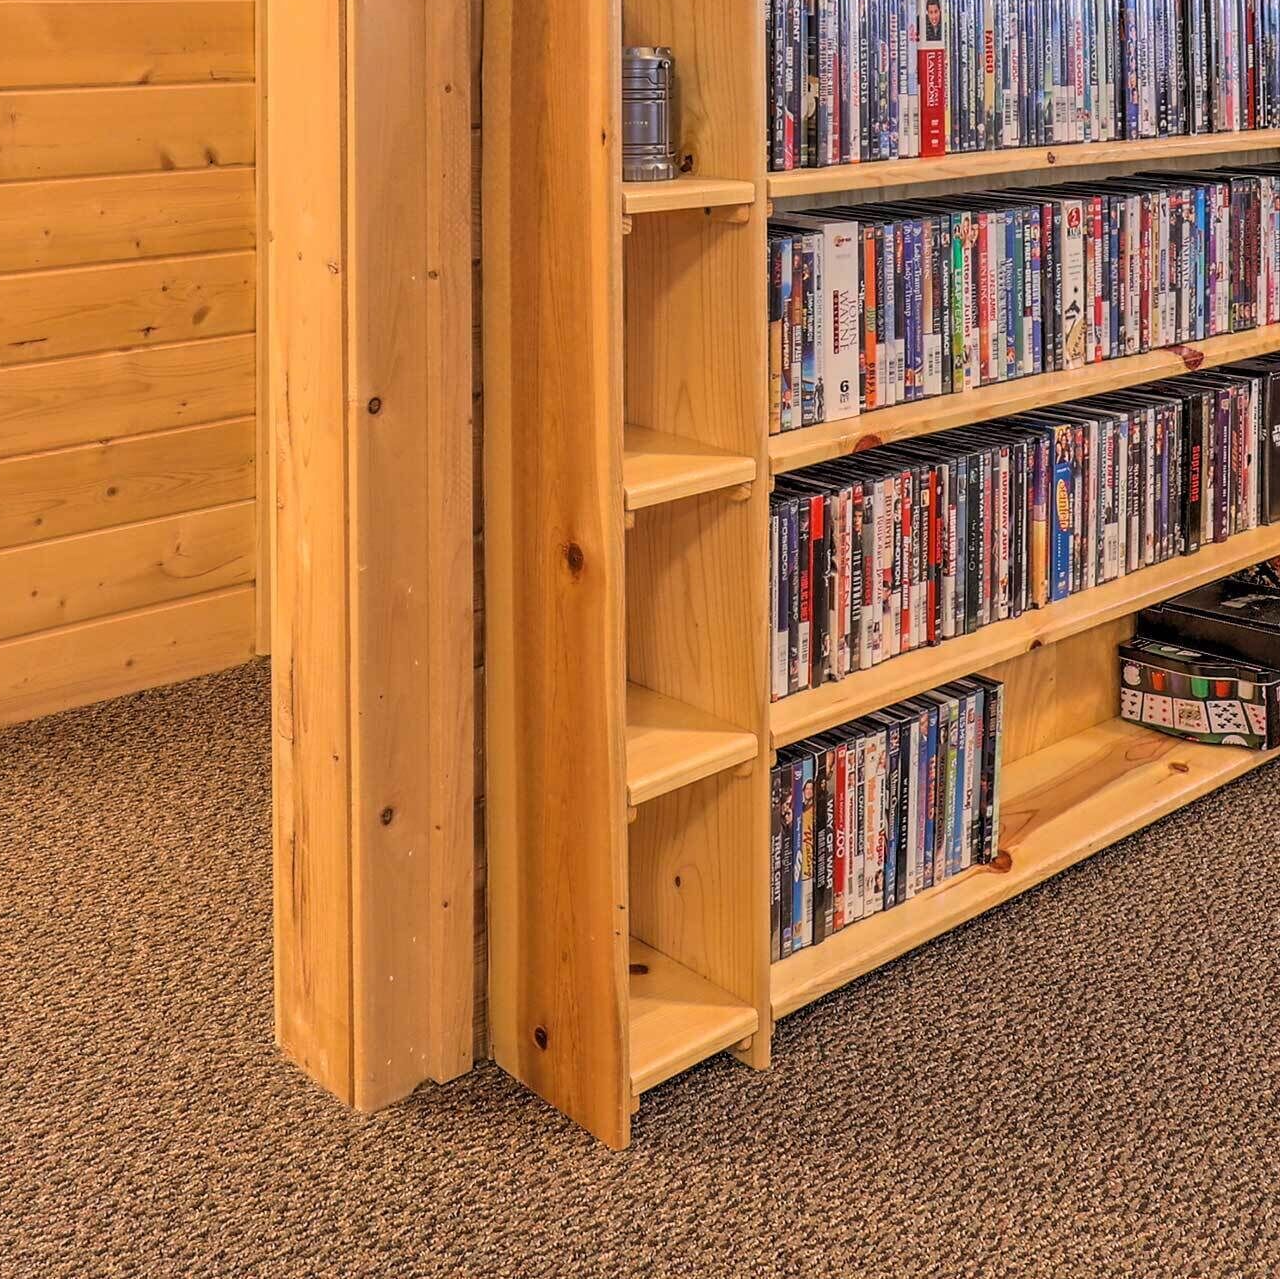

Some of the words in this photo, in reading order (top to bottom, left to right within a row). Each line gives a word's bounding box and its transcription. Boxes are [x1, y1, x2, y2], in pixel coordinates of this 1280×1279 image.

[899, 30, 907, 66] EASTERN
[1076, 20, 1084, 50] FOUR
[775, 26, 783, 87] DEATH
[785, 46, 793, 66] DEEP
[860, 38, 868, 104] disturbia
[785, 68, 793, 92] COVER
[899, 68, 907, 94] PROM
[927, 51, 936, 107] RAYMOND
[1076, 55, 1084, 97] ROOMS
[775, 94, 783, 142] RACE
[1024, 224, 1032, 242] LIVE
[913, 242, 923, 262] Lady
[1024, 242, 1032, 262] FREE
[1094, 238, 1103, 297] MARMADUKE
[904, 260, 914, 283] Lady
[913, 269, 923, 295] Tramp
[904, 289, 914, 317] Tramp
[1024, 282, 1032, 307] HARD
[839, 290, 849, 352] WAYNE
[848, 299, 858, 346] JOHN
[839, 380, 850, 393] 6
[884, 495, 892, 517] RED
[1001, 471, 1009, 529] RUNAWAY
[884, 518, 892, 549] RIVER
[912, 505, 920, 554] RESCUE
[1001, 531, 1009, 561] JURY
[800, 570, 809, 600] PUBLIC
[852, 570, 861, 621] RAINMAKER
[888, 770, 898, 796] White
[927, 753, 937, 782] THE
[901, 777, 909, 810] WHITE
[927, 783, 937, 821] WILD
[825, 798, 834, 829] WAY
[825, 830, 834, 853] OF
[836, 828, 845, 858] ZOO
[877, 828, 887, 867] Vegas
[901, 816, 909, 850] NOISE
[773, 832, 782, 870] TRUE
[782, 837, 791, 874] twilight
[773, 871, 782, 903] GRIT
[825, 854, 834, 889] WAR
